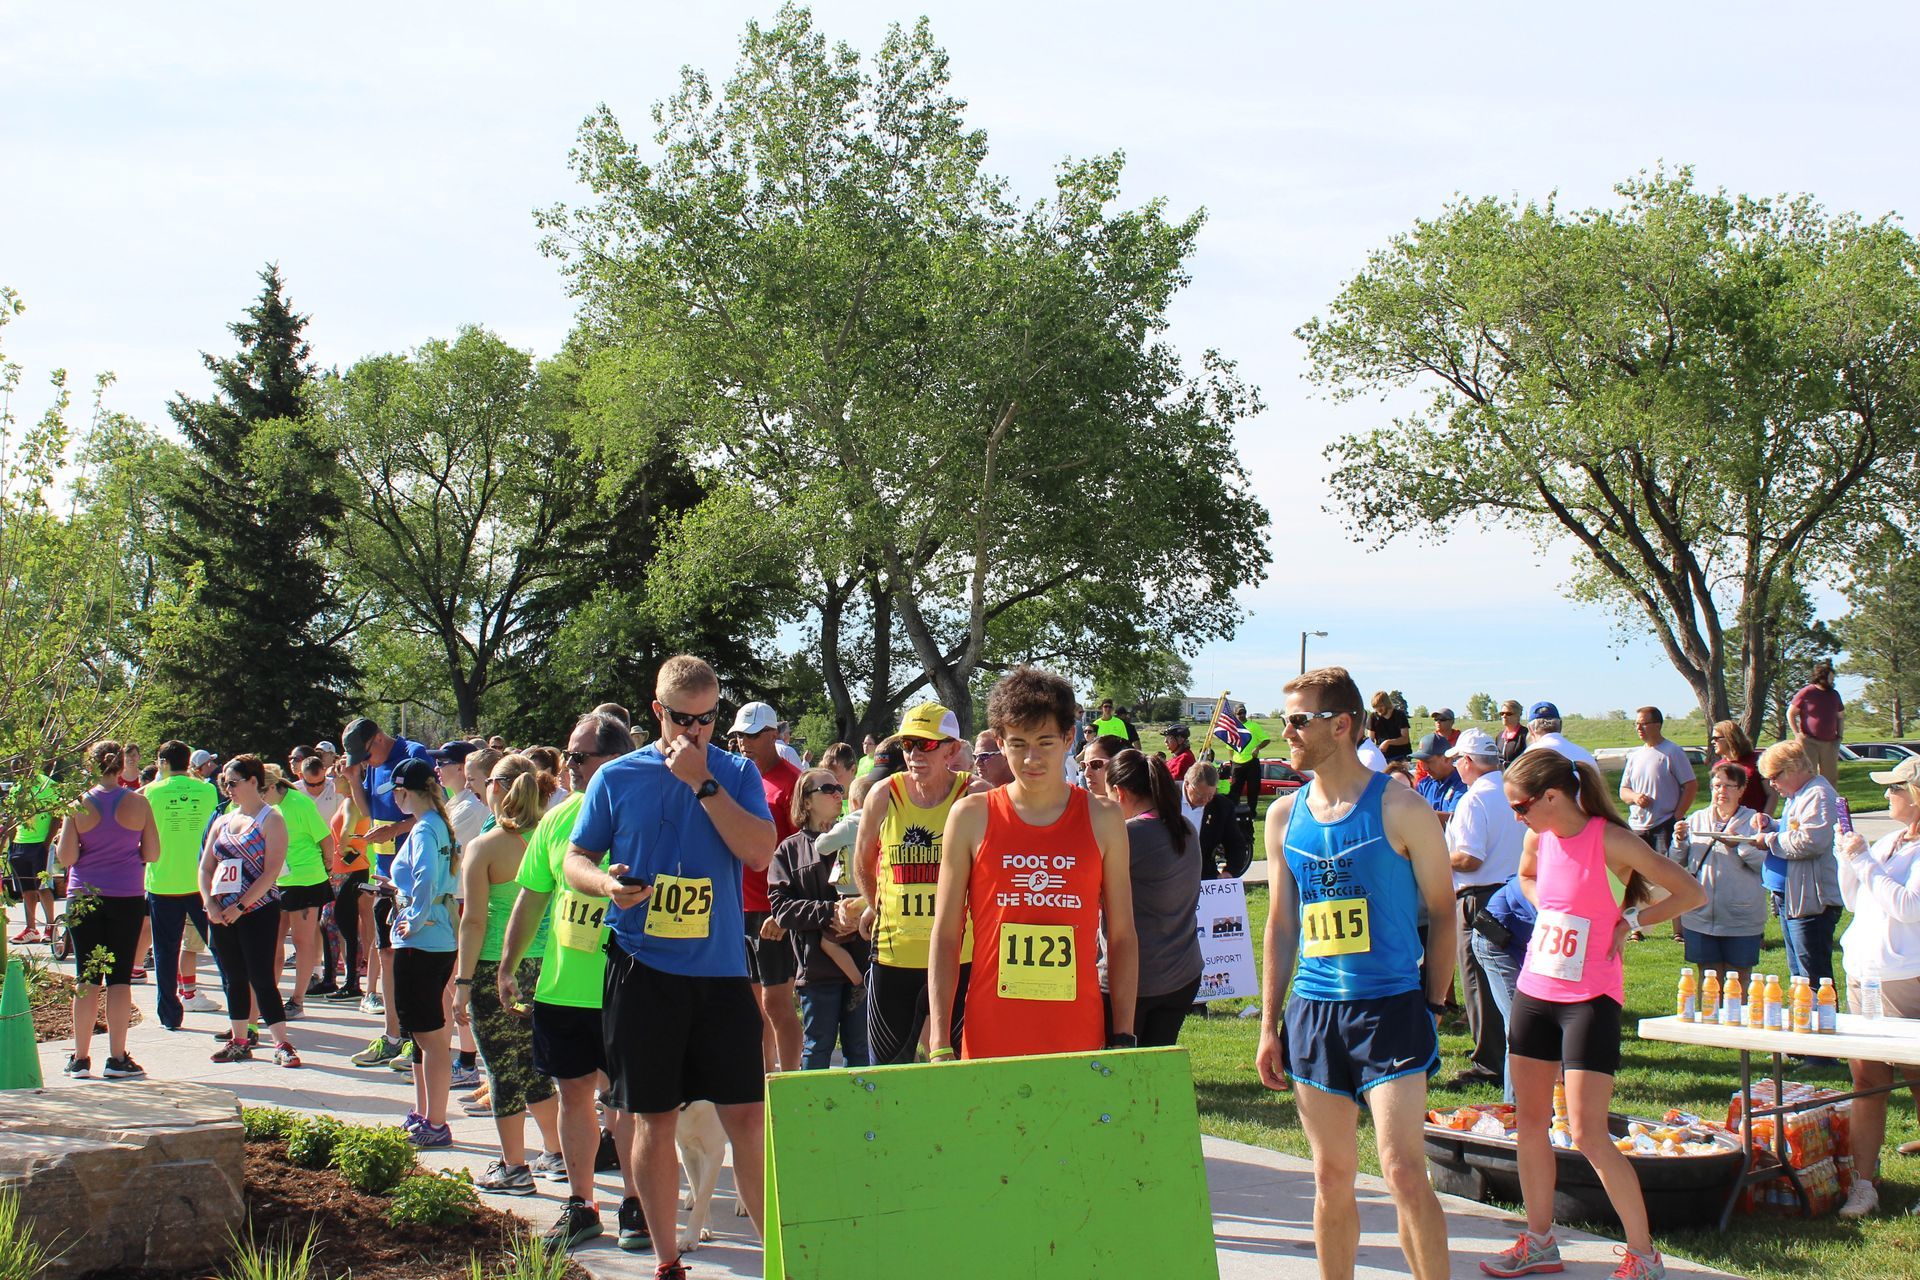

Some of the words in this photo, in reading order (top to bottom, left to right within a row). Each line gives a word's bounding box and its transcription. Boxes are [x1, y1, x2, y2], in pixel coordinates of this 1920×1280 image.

[1003, 855, 1049, 869] FOOT
[1052, 855, 1076, 870] OF
[1303, 859, 1335, 872] FOOT
[1338, 858, 1354, 869] OF
[651, 882, 711, 915] 1025
[997, 892, 1020, 907] THE
[1023, 892, 1082, 909] ROCKIES
[1320, 885, 1368, 898] ROCKIES
[561, 899, 604, 929] 1114
[1308, 908, 1363, 941] 1115
[1006, 934, 1072, 968] 1123
[1538, 924, 1579, 957] 736
